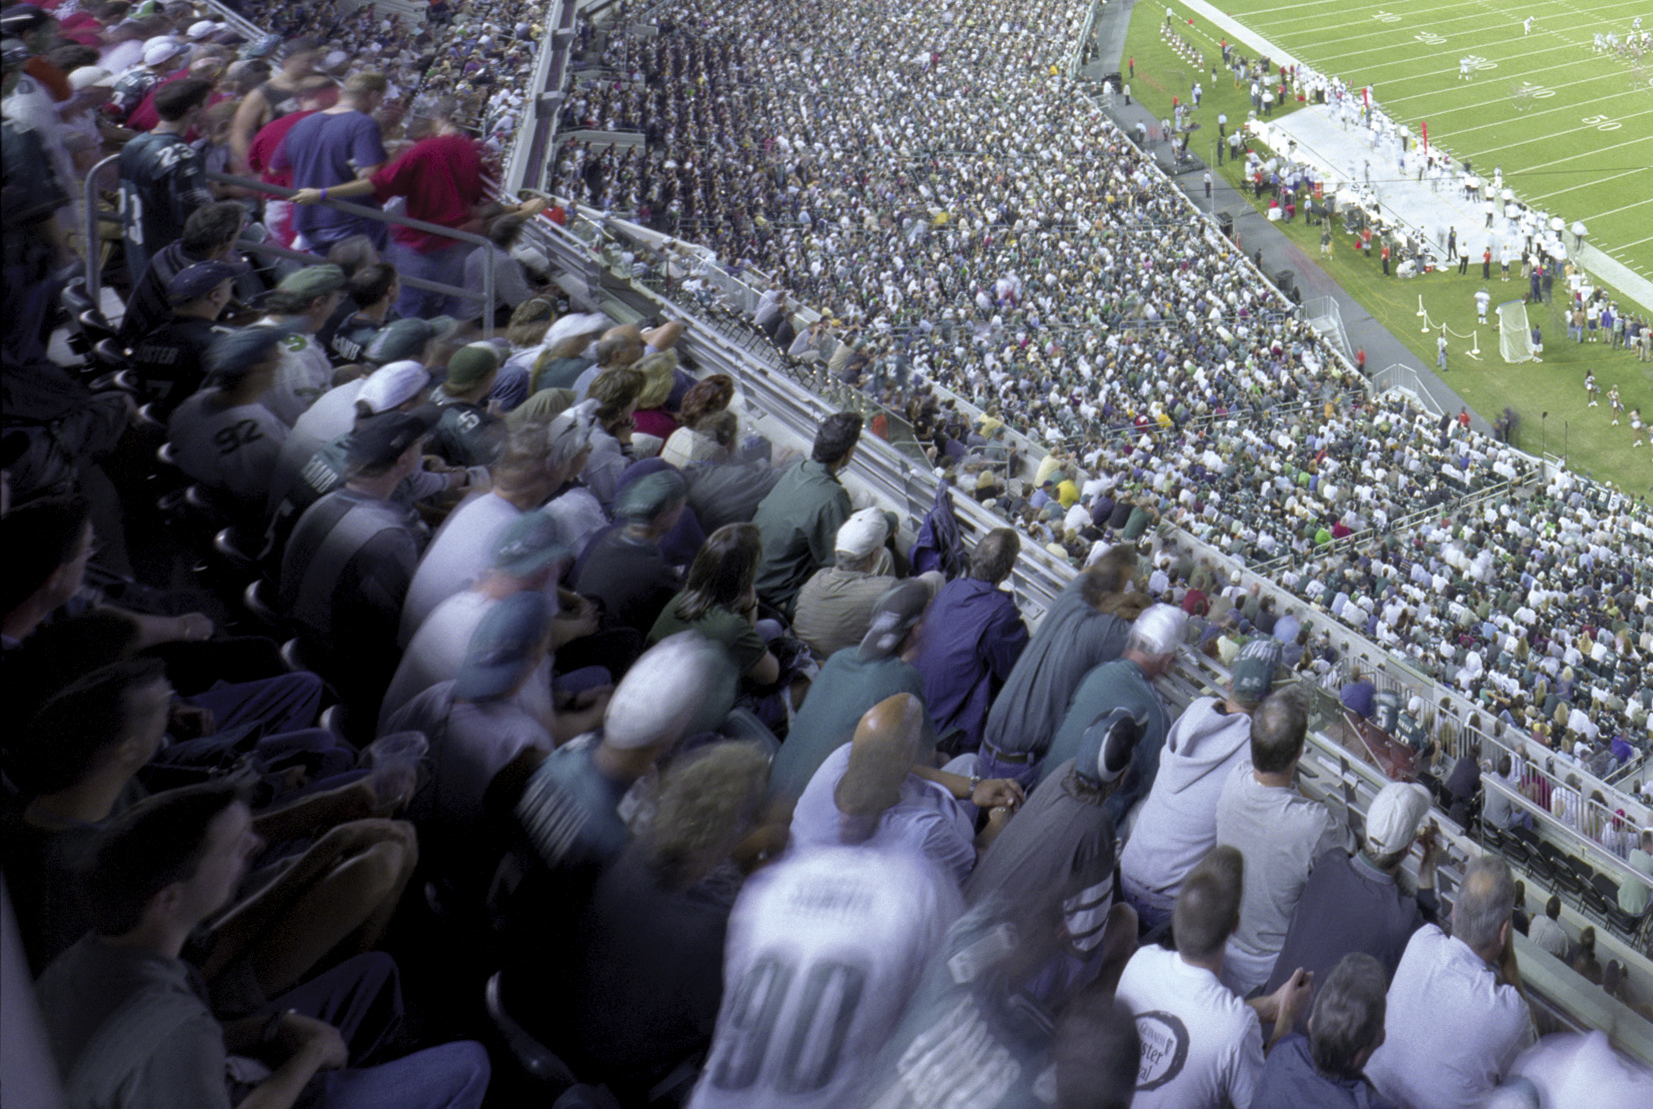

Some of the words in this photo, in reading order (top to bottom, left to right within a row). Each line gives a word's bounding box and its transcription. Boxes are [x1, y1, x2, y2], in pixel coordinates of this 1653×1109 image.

[1582, 114, 1622, 131] 50
[156, 143, 196, 168] 23
[214, 417, 263, 455] 92
